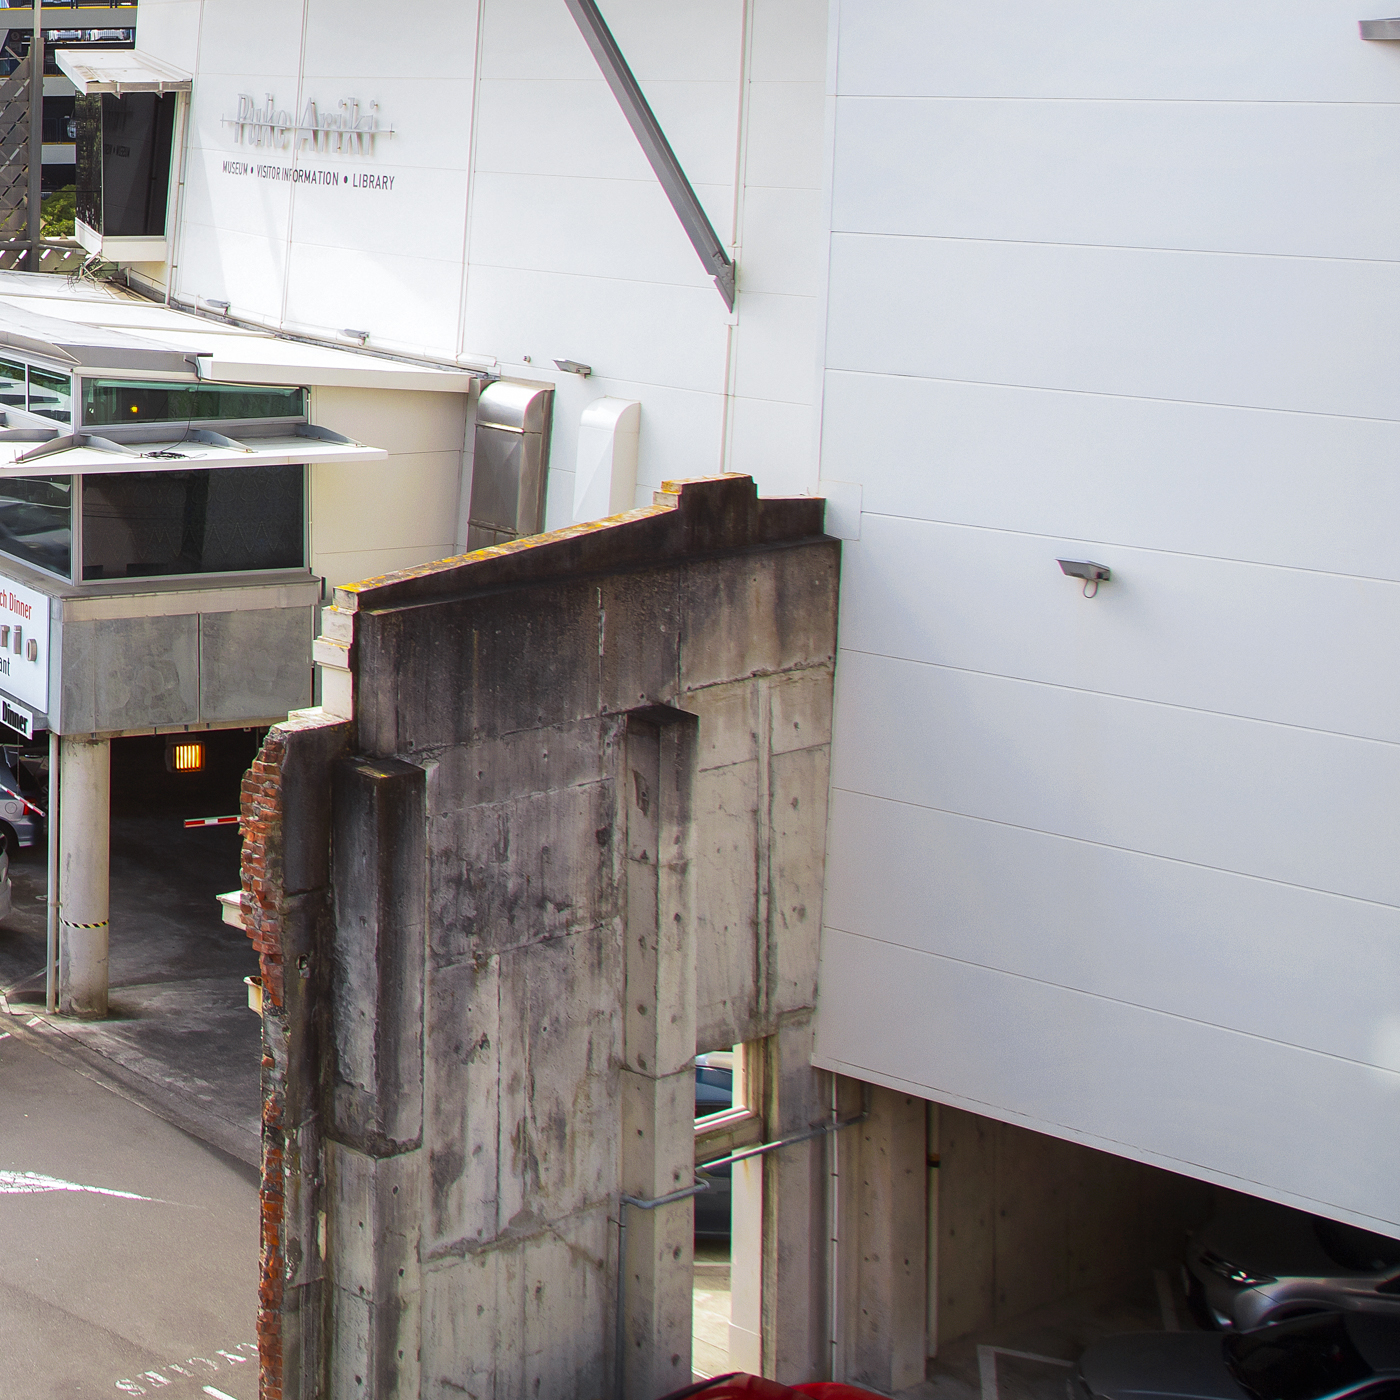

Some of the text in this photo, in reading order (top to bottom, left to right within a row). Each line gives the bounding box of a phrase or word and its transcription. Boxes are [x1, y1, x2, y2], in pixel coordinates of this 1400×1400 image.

[234, 93, 375, 156] Puke Ariki
[222, 160, 395, 190] MUSEUM VISITOR INFORMATION LIBRARY
[9, 592, 32, 620] Dinner
[2, 700, 29, 734] Dinner
